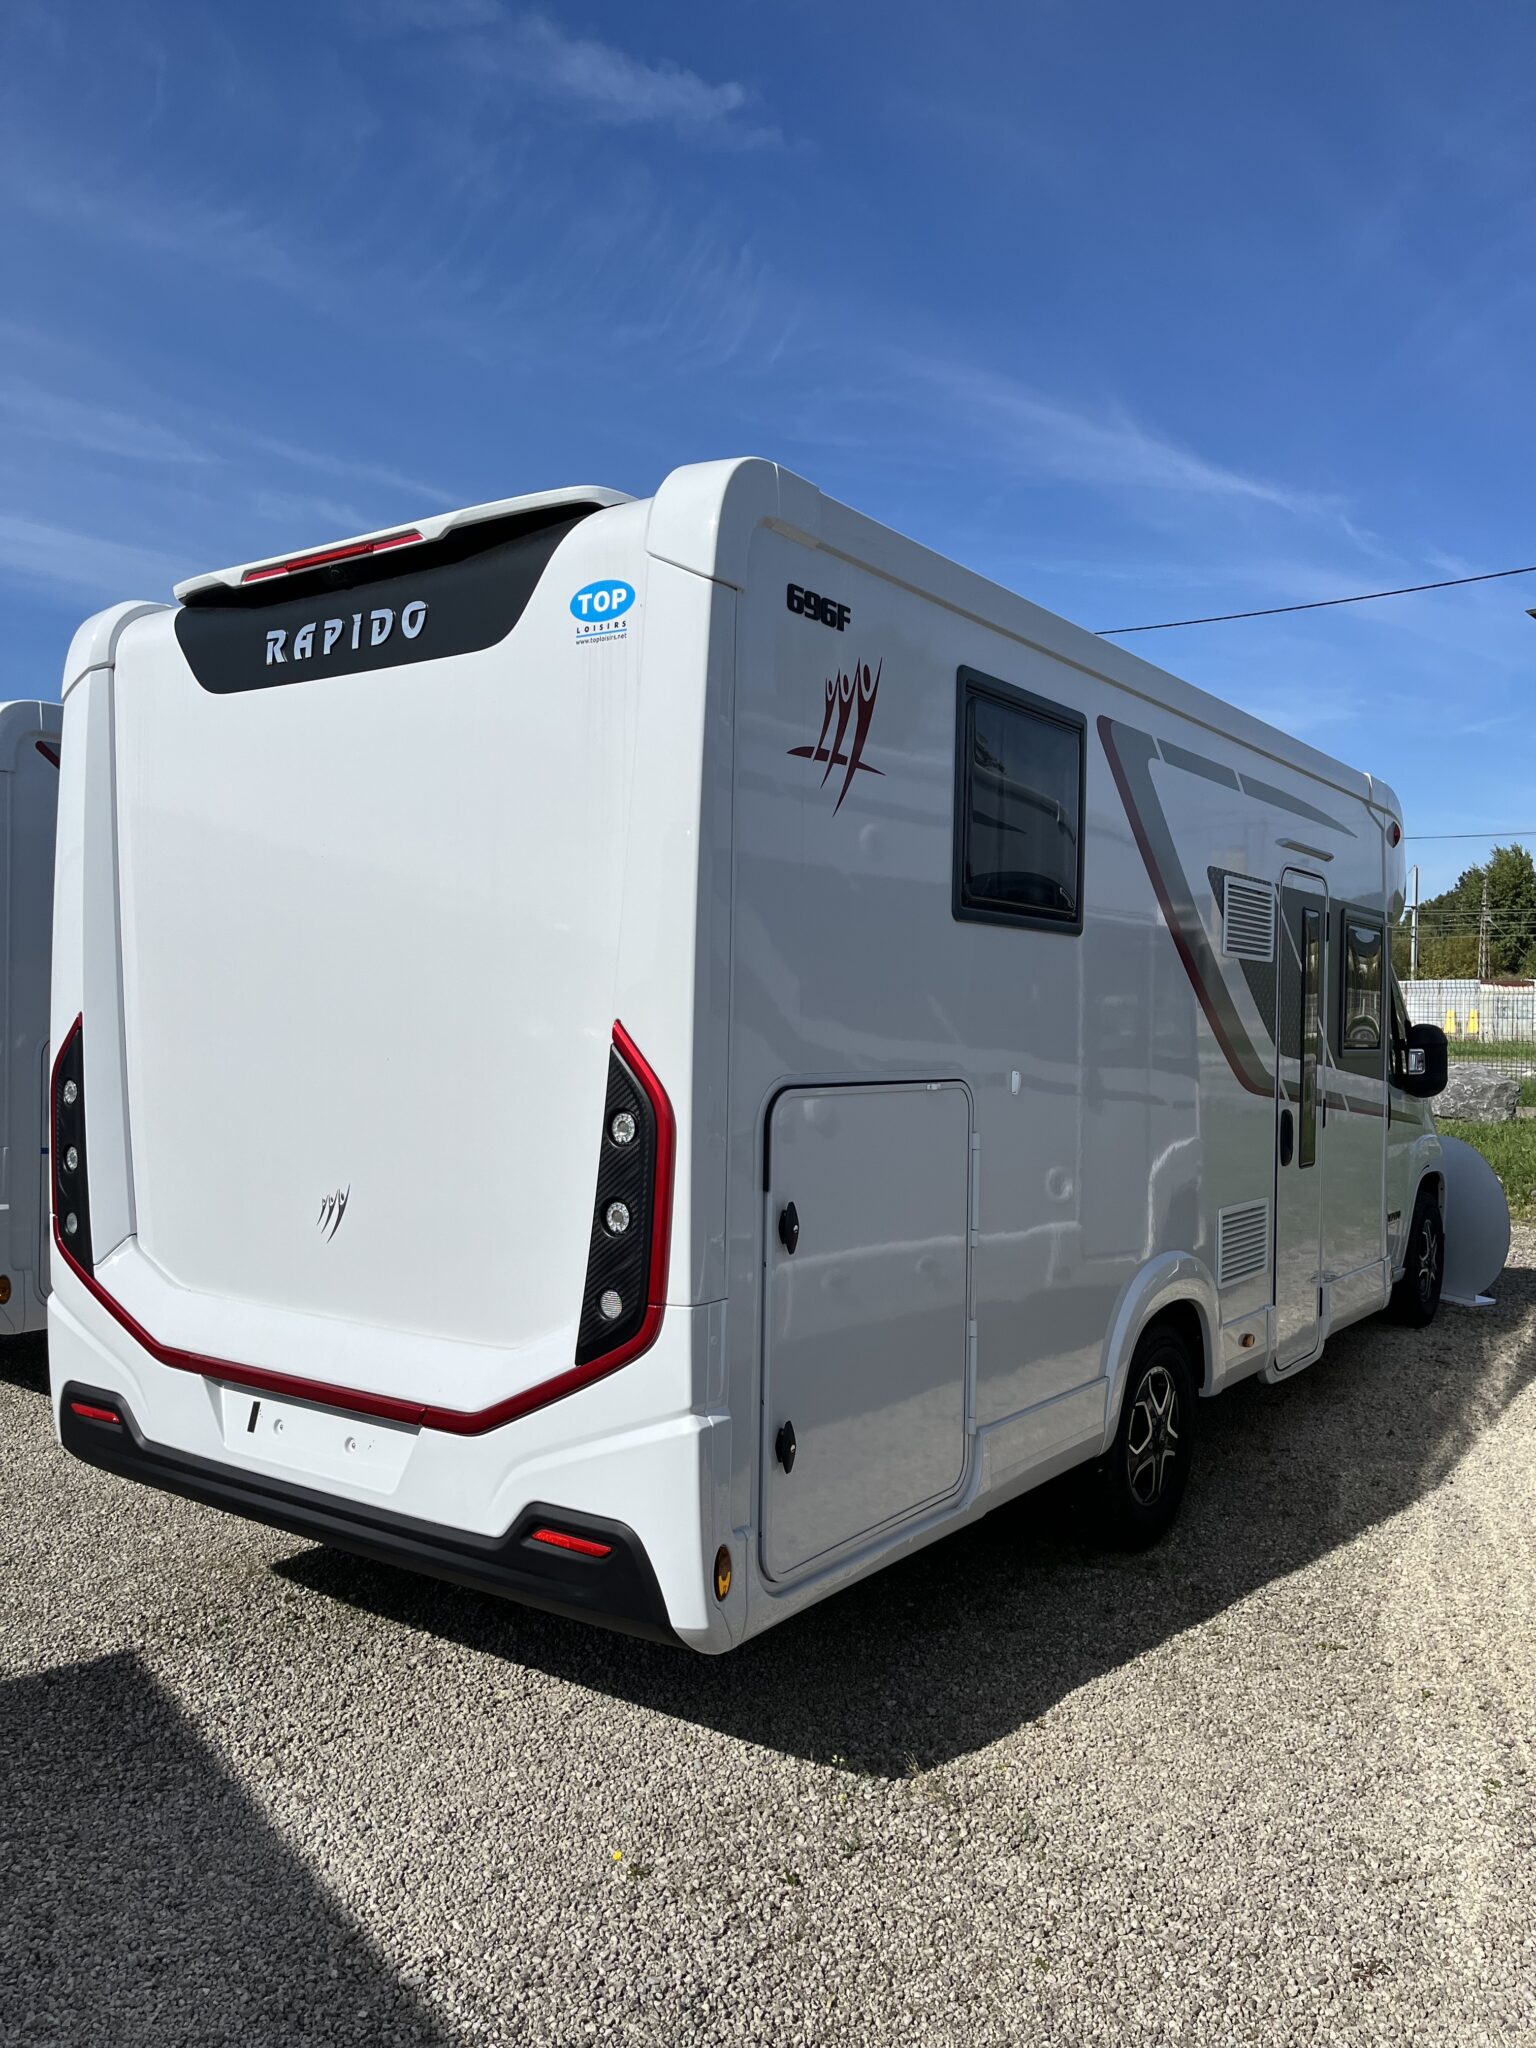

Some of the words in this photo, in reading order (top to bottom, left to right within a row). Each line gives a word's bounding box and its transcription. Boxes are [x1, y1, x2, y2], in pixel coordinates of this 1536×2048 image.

[577, 588, 627, 615] TOP
[787, 583, 851, 632] 696F
[266, 600, 428, 665] RAPIDO
[575, 633, 627, 645] www.toploisirs.net
[576, 620, 627, 634] LOISIRS
